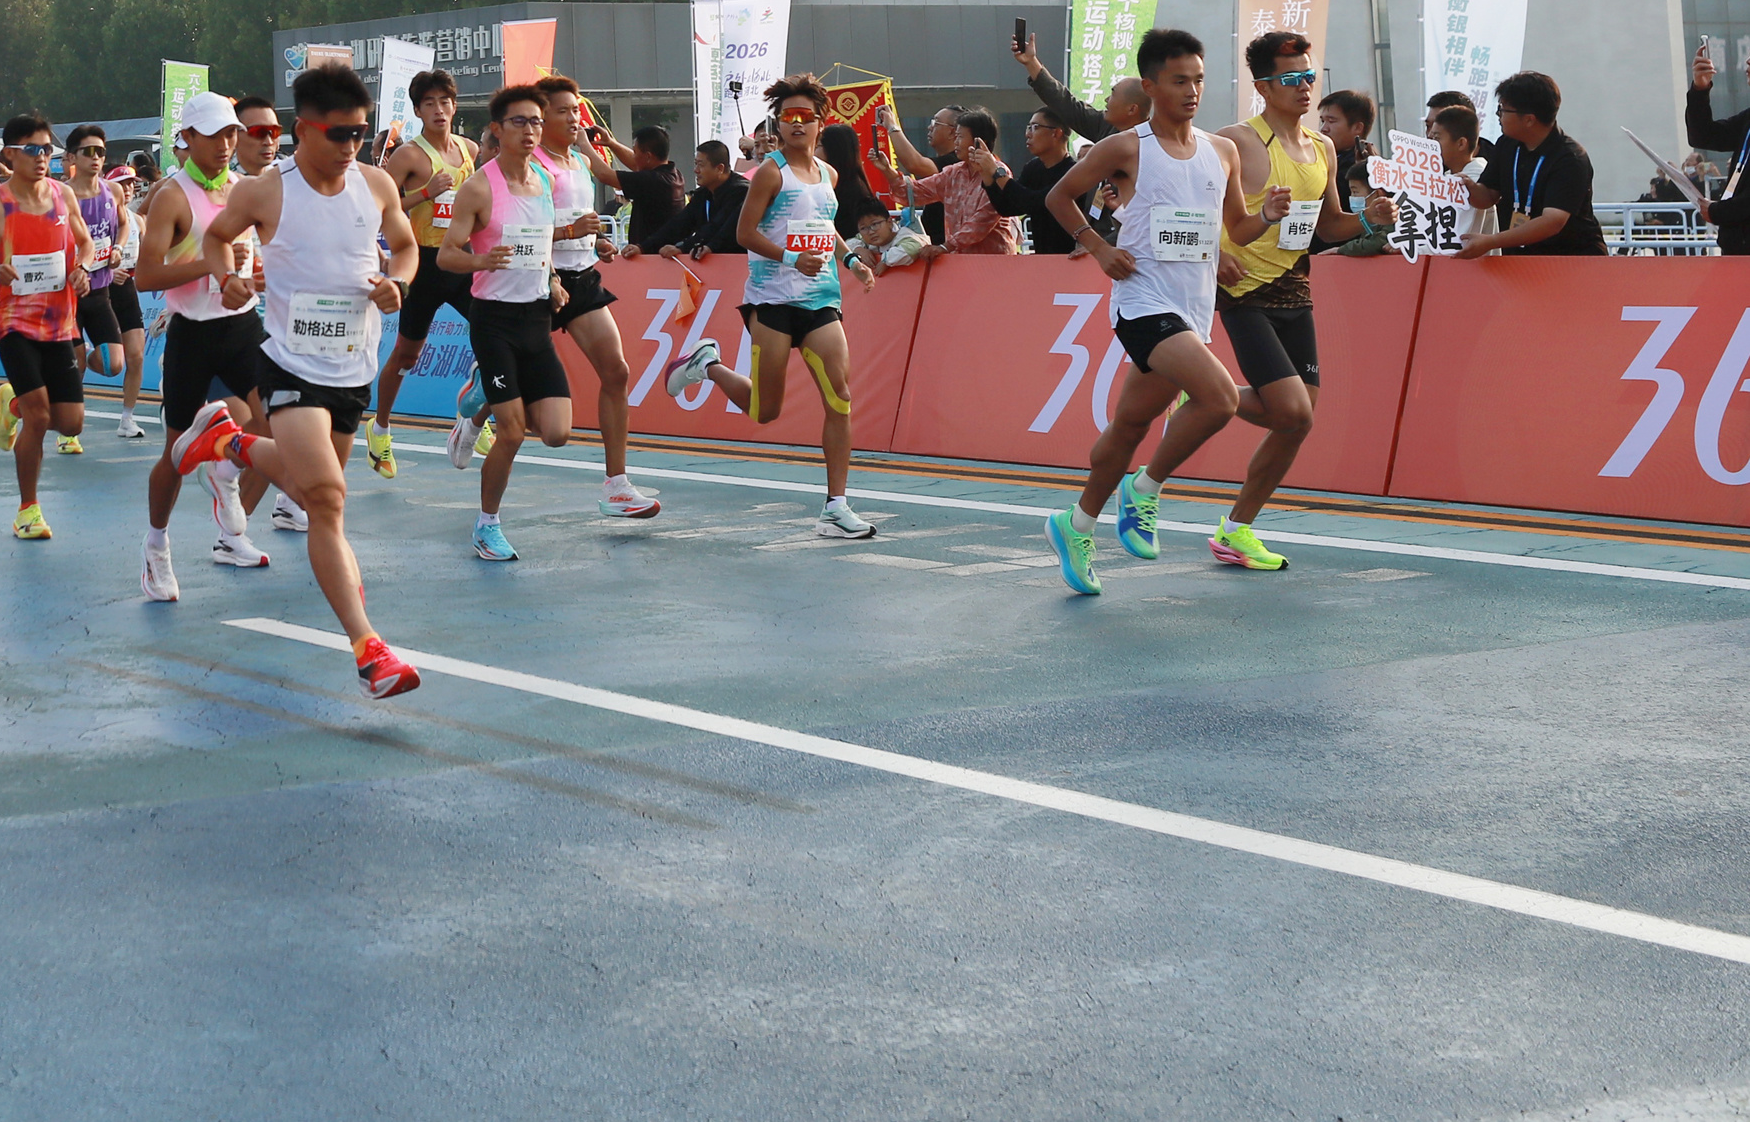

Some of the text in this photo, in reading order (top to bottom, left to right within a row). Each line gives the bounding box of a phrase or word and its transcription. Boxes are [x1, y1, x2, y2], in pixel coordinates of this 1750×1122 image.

[725, 42, 768, 59] 2026
[1082, 0, 1110, 104] 运动搭子
[189, 73, 201, 98] 六个
[1392, 134, 1409, 145] OPPO
[1410, 139, 1430, 149] Watch
[1395, 146, 1441, 173] 2026
[1372, 160, 1465, 205] 衡水马拉松
[1392, 191, 1463, 259] 拿捏
[791, 235, 833, 248] A14735
[1159, 230, 1199, 246] 向新鹏
[95, 248, 110, 259] 662
[293, 319, 346, 337] 勒格达且
[1027, 293, 1134, 434] 36
[1597, 306, 1750, 486] 36
